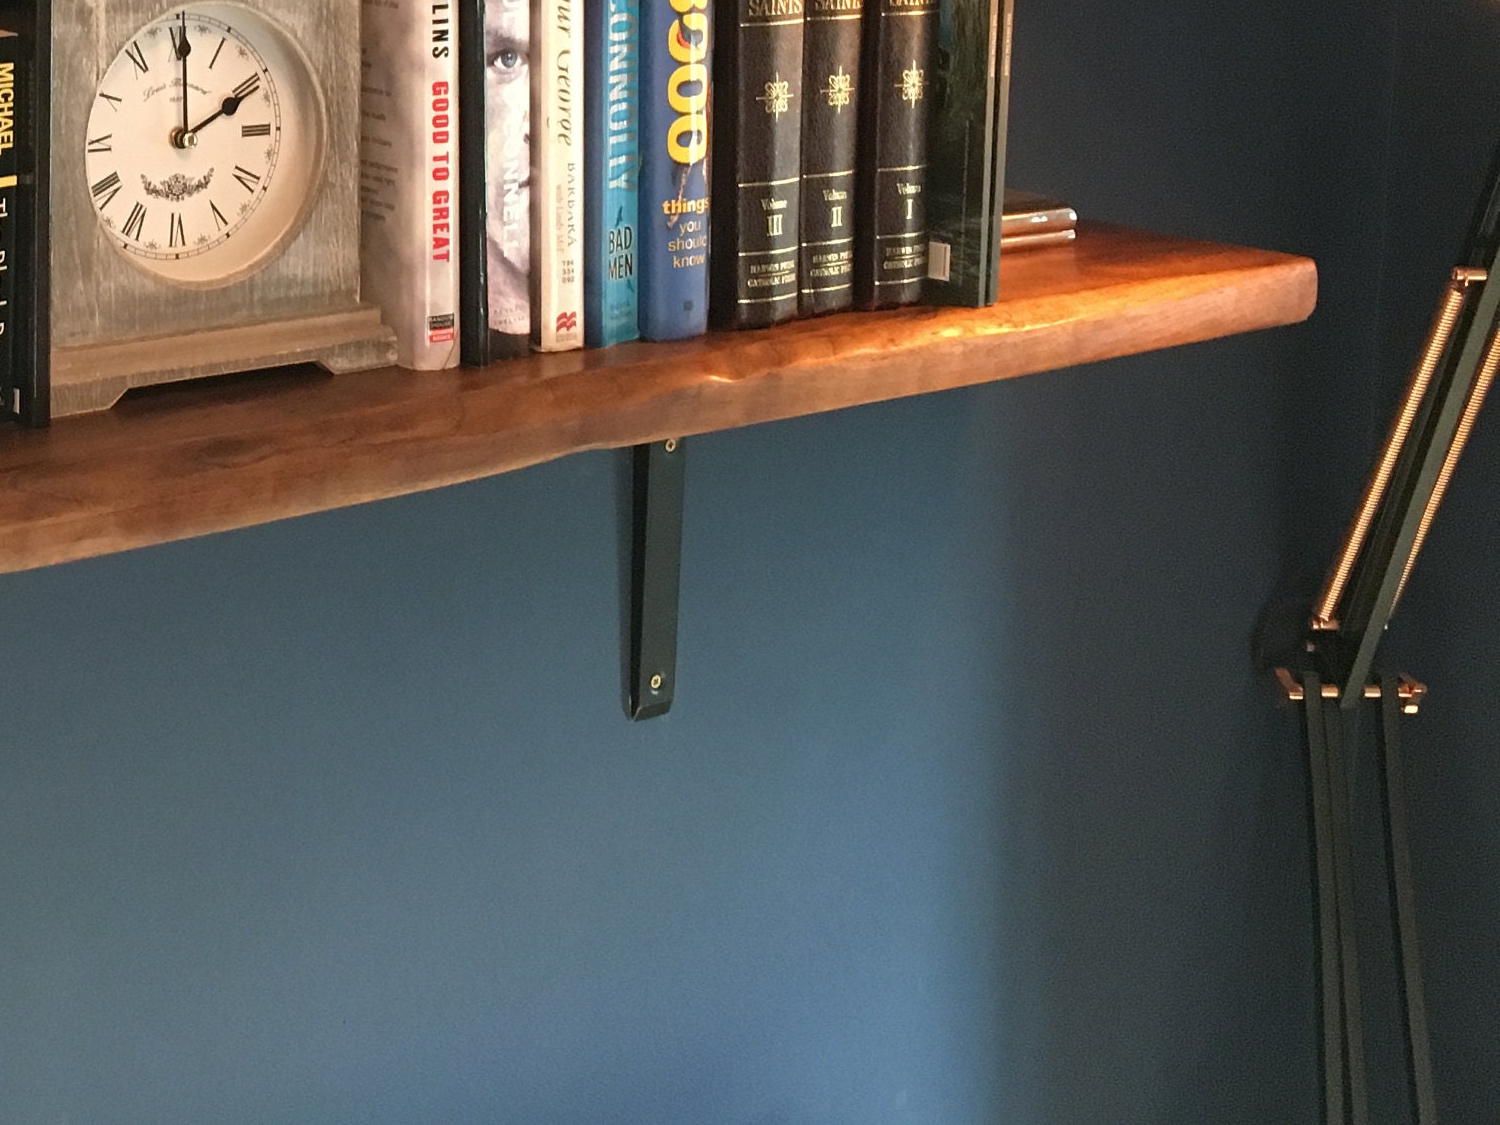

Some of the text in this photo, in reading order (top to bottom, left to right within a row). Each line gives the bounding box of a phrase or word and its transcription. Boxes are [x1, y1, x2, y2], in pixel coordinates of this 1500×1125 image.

[547, 50, 573, 148] George
[431, 81, 450, 263] GOOD TO GREAT
[662, 197, 711, 216] things
[761, 197, 788, 210] Volume
[905, 198, 914, 220] I
[766, 213, 783, 237] III
[830, 206, 843, 228] II
[679, 221, 702, 236] you
[609, 226, 634, 254] BAD
[608, 253, 634, 281] MEN
[673, 254, 707, 269] know
